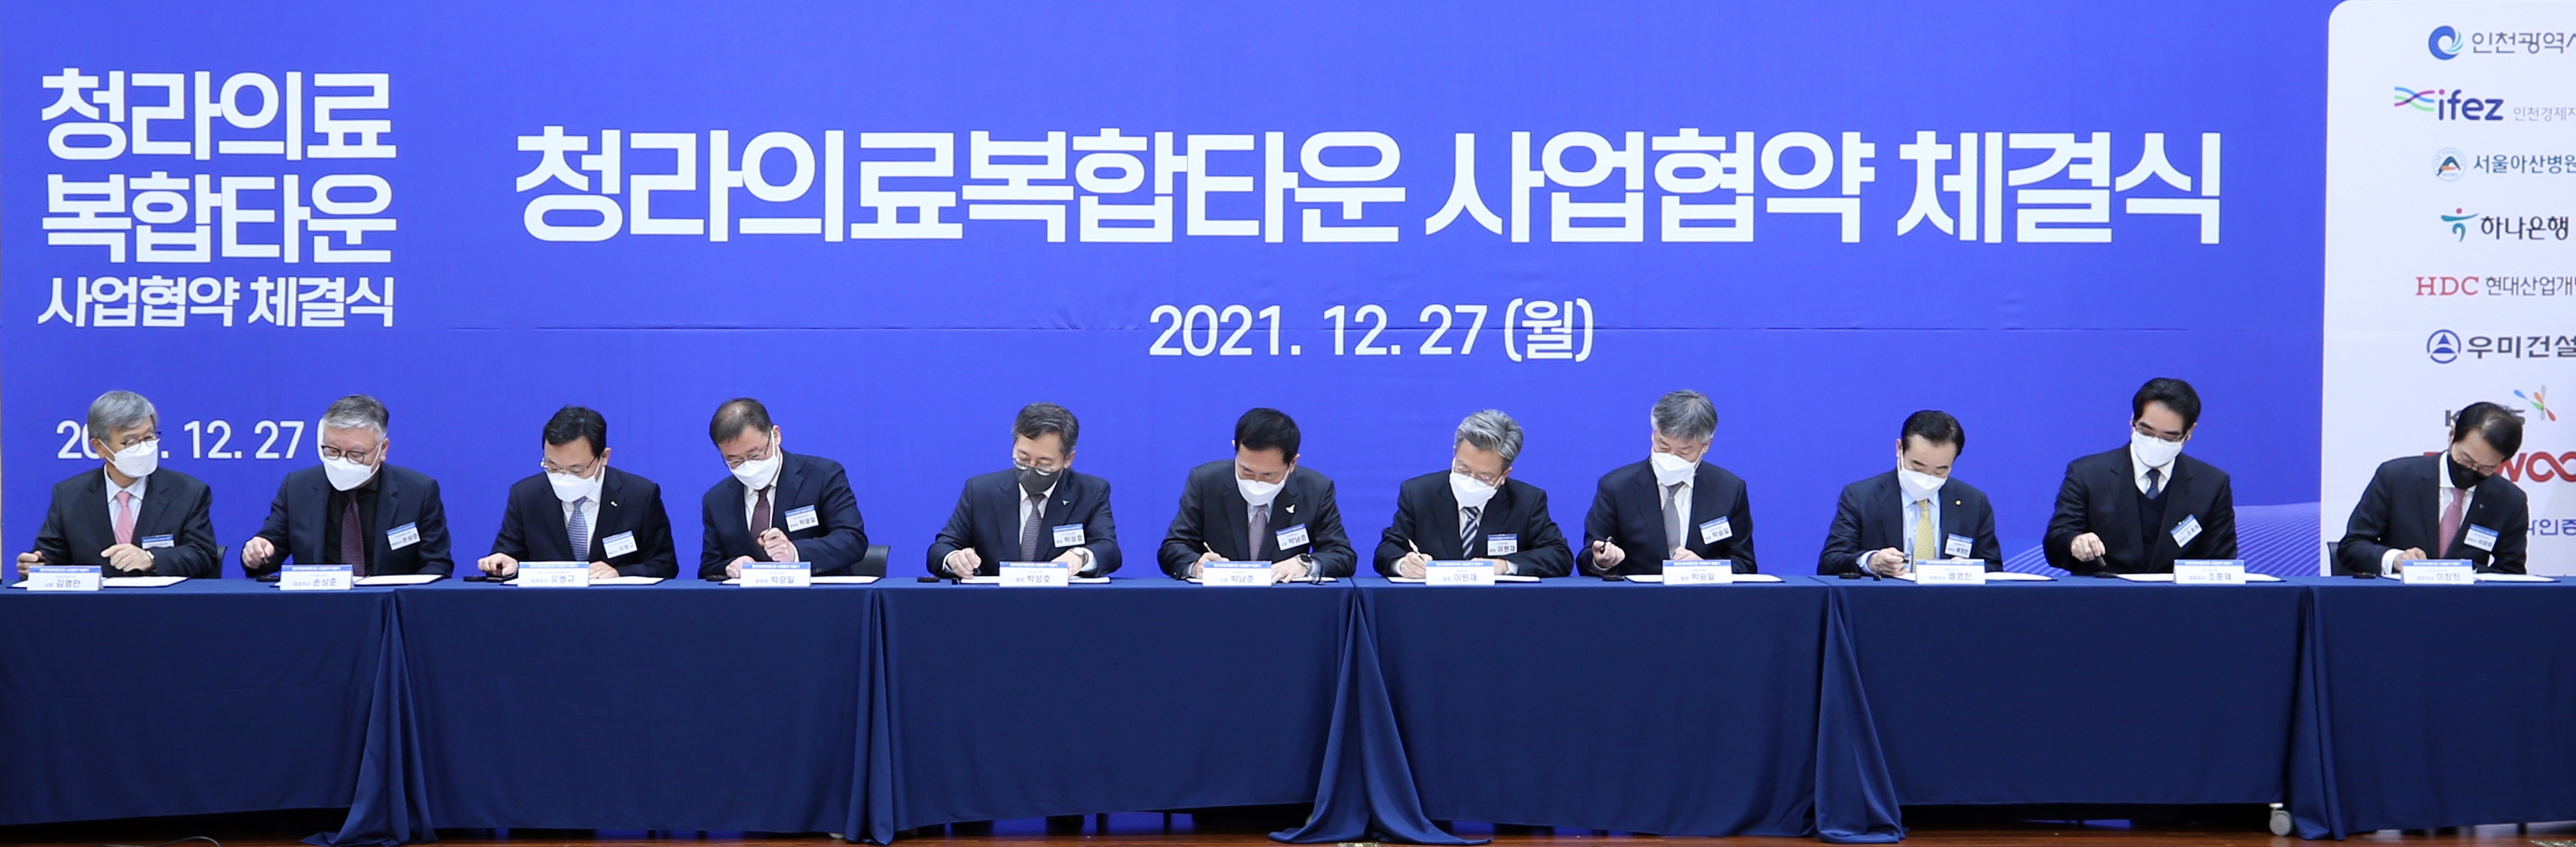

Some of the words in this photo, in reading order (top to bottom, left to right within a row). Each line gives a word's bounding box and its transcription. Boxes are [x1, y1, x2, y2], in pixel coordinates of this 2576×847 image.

[2472, 31, 2576, 54] 인천광역
[41, 68, 397, 160] 청라의료
[2438, 88, 2505, 121] ifez
[515, 125, 1407, 243] 청라의료복합타운
[1425, 127, 1876, 243] 사업협약
[1896, 130, 2222, 244] 체결식
[42, 171, 397, 263] 복합타운
[2480, 215, 2570, 241] 하나은행
[2415, 276, 2479, 296] HDC
[2485, 276, 2576, 297] 현대산업개
[37, 275, 241, 327] 사업협약
[247, 275, 395, 328] 체결식
[1148, 304, 1302, 357] 2021.
[1323, 304, 1401, 356] 12.
[1419, 304, 1488, 355] 27
[1504, 297, 1593, 363] (월)
[2467, 335, 2576, 359] 우미건설
[184, 420, 242, 459] 12.
[254, 420, 305, 459] 27
[313, 577, 337, 586] 손상준
[551, 575, 575, 584] 유병규
[771, 575, 795, 584] 박광일
[1027, 575, 1051, 583] 박성호
[1453, 573, 1477, 582] 이원재
[1692, 573, 1715, 581] 박승일
